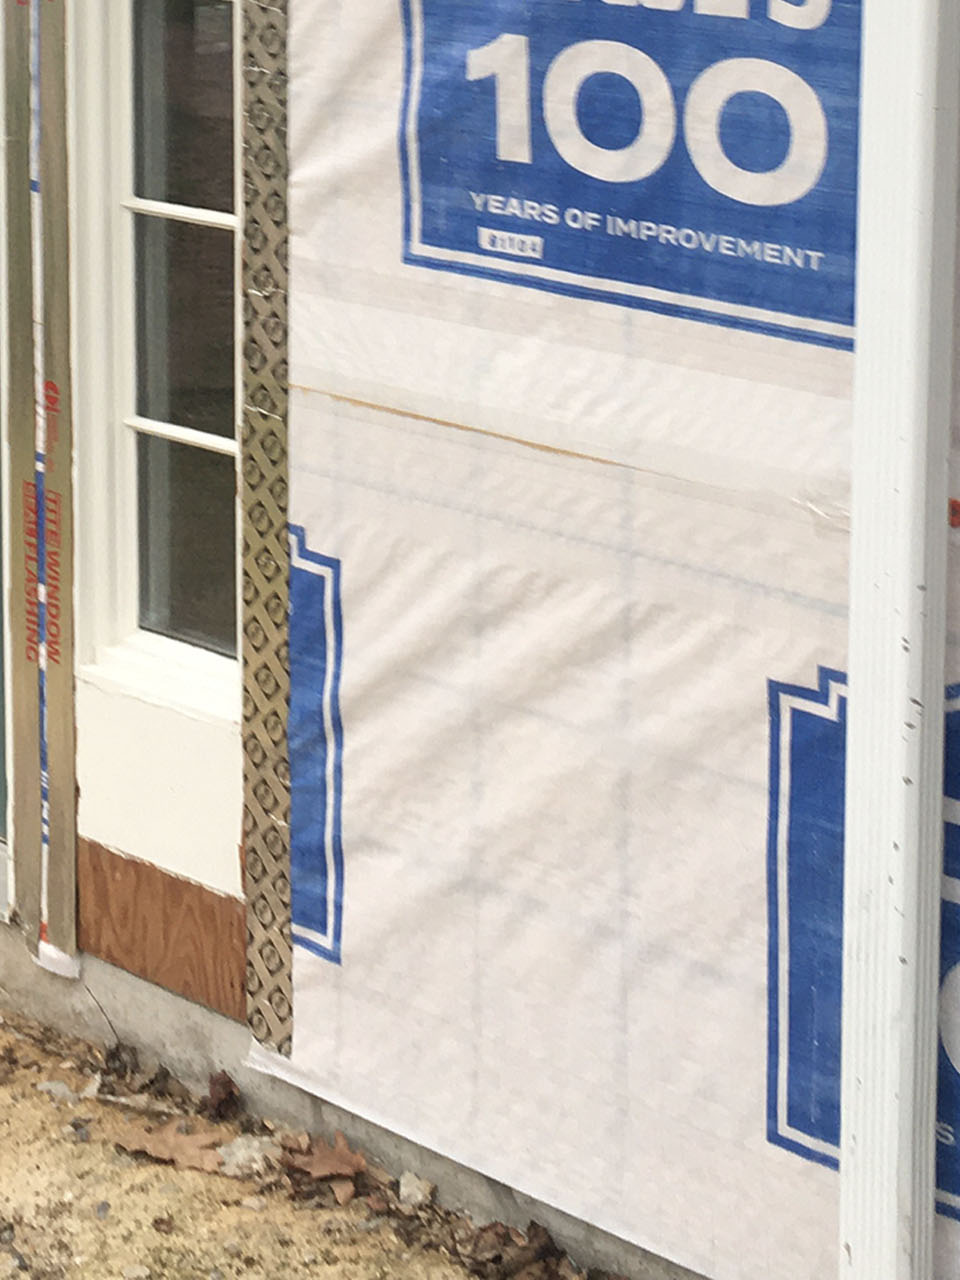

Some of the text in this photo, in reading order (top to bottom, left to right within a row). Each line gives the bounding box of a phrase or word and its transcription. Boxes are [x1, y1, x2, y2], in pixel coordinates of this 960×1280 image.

[464, 32, 829, 208] 100
[469, 192, 825, 272] YEARS OF IMPROVEMENT
[46, 550, 62, 665] WINDOW
